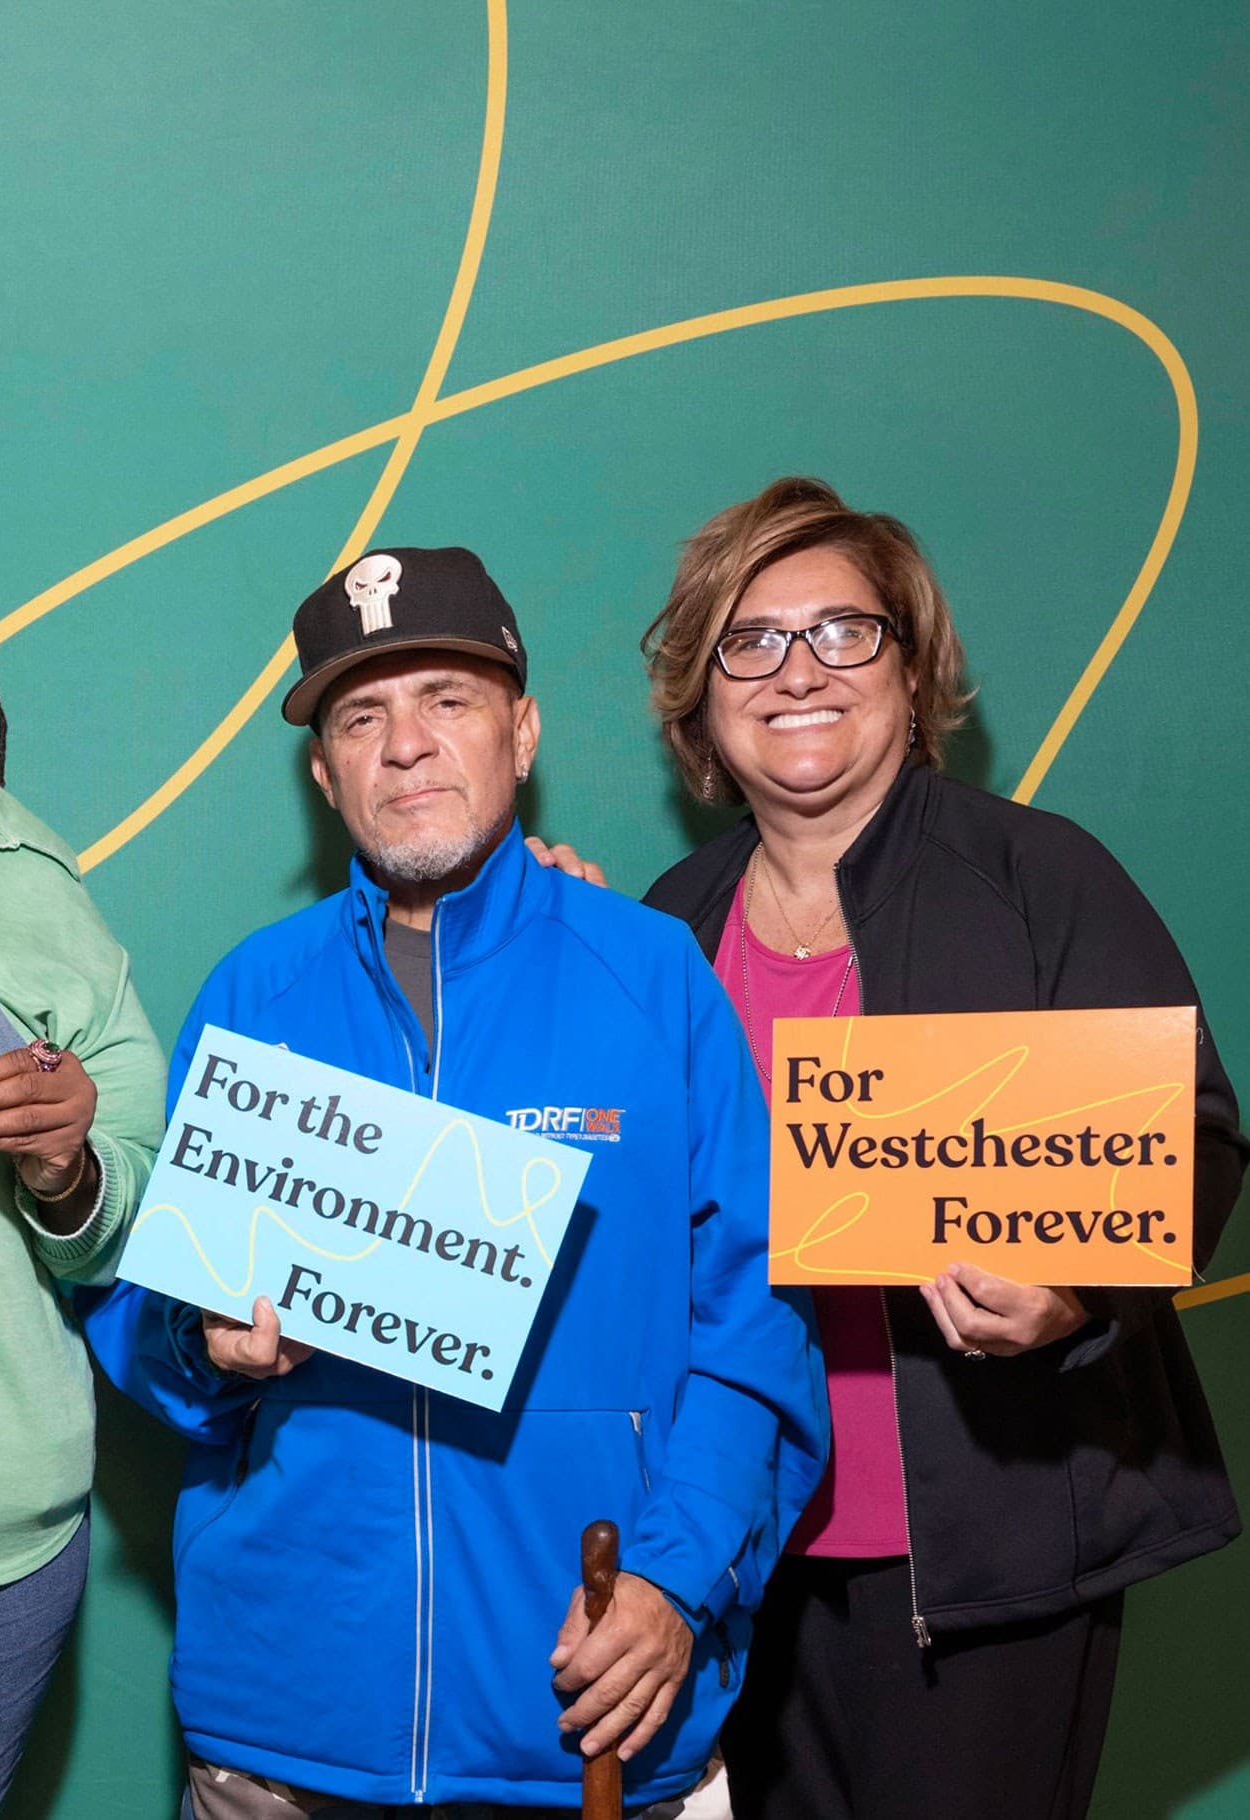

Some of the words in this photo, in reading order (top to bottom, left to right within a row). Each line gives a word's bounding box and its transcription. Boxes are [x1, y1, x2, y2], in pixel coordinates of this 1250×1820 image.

[194, 1053, 289, 1121] For
[299, 1094, 383, 1155] the
[786, 1056, 884, 1104] For
[786, 1117, 1178, 1169] Westchester.
[169, 1121, 533, 1290] Environment.
[931, 1196, 1178, 1244] Forever.
[276, 1263, 495, 1382] Forever.
